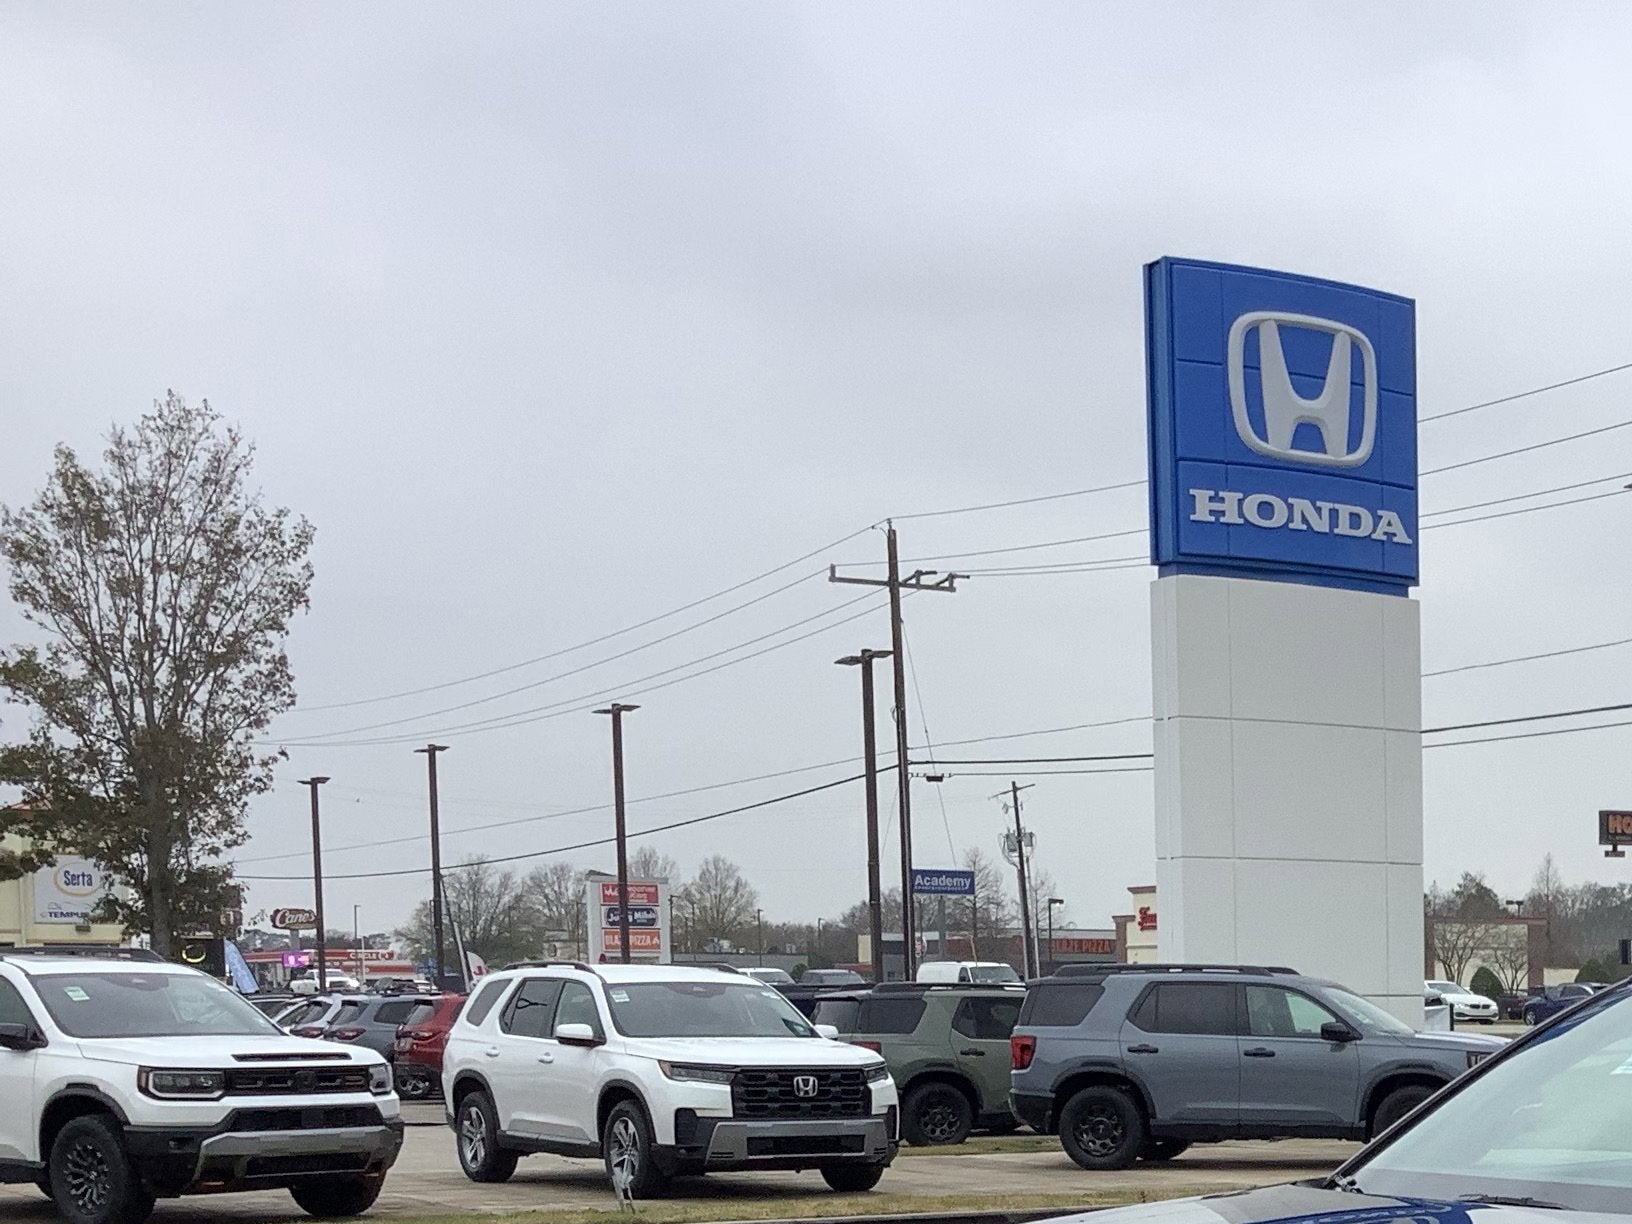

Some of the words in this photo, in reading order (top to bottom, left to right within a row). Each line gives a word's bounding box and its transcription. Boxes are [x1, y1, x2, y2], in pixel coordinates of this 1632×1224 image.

[1189, 488, 1413, 545] HONDA
[64, 869, 93, 887] Serta
[915, 874, 971, 890] Academy
